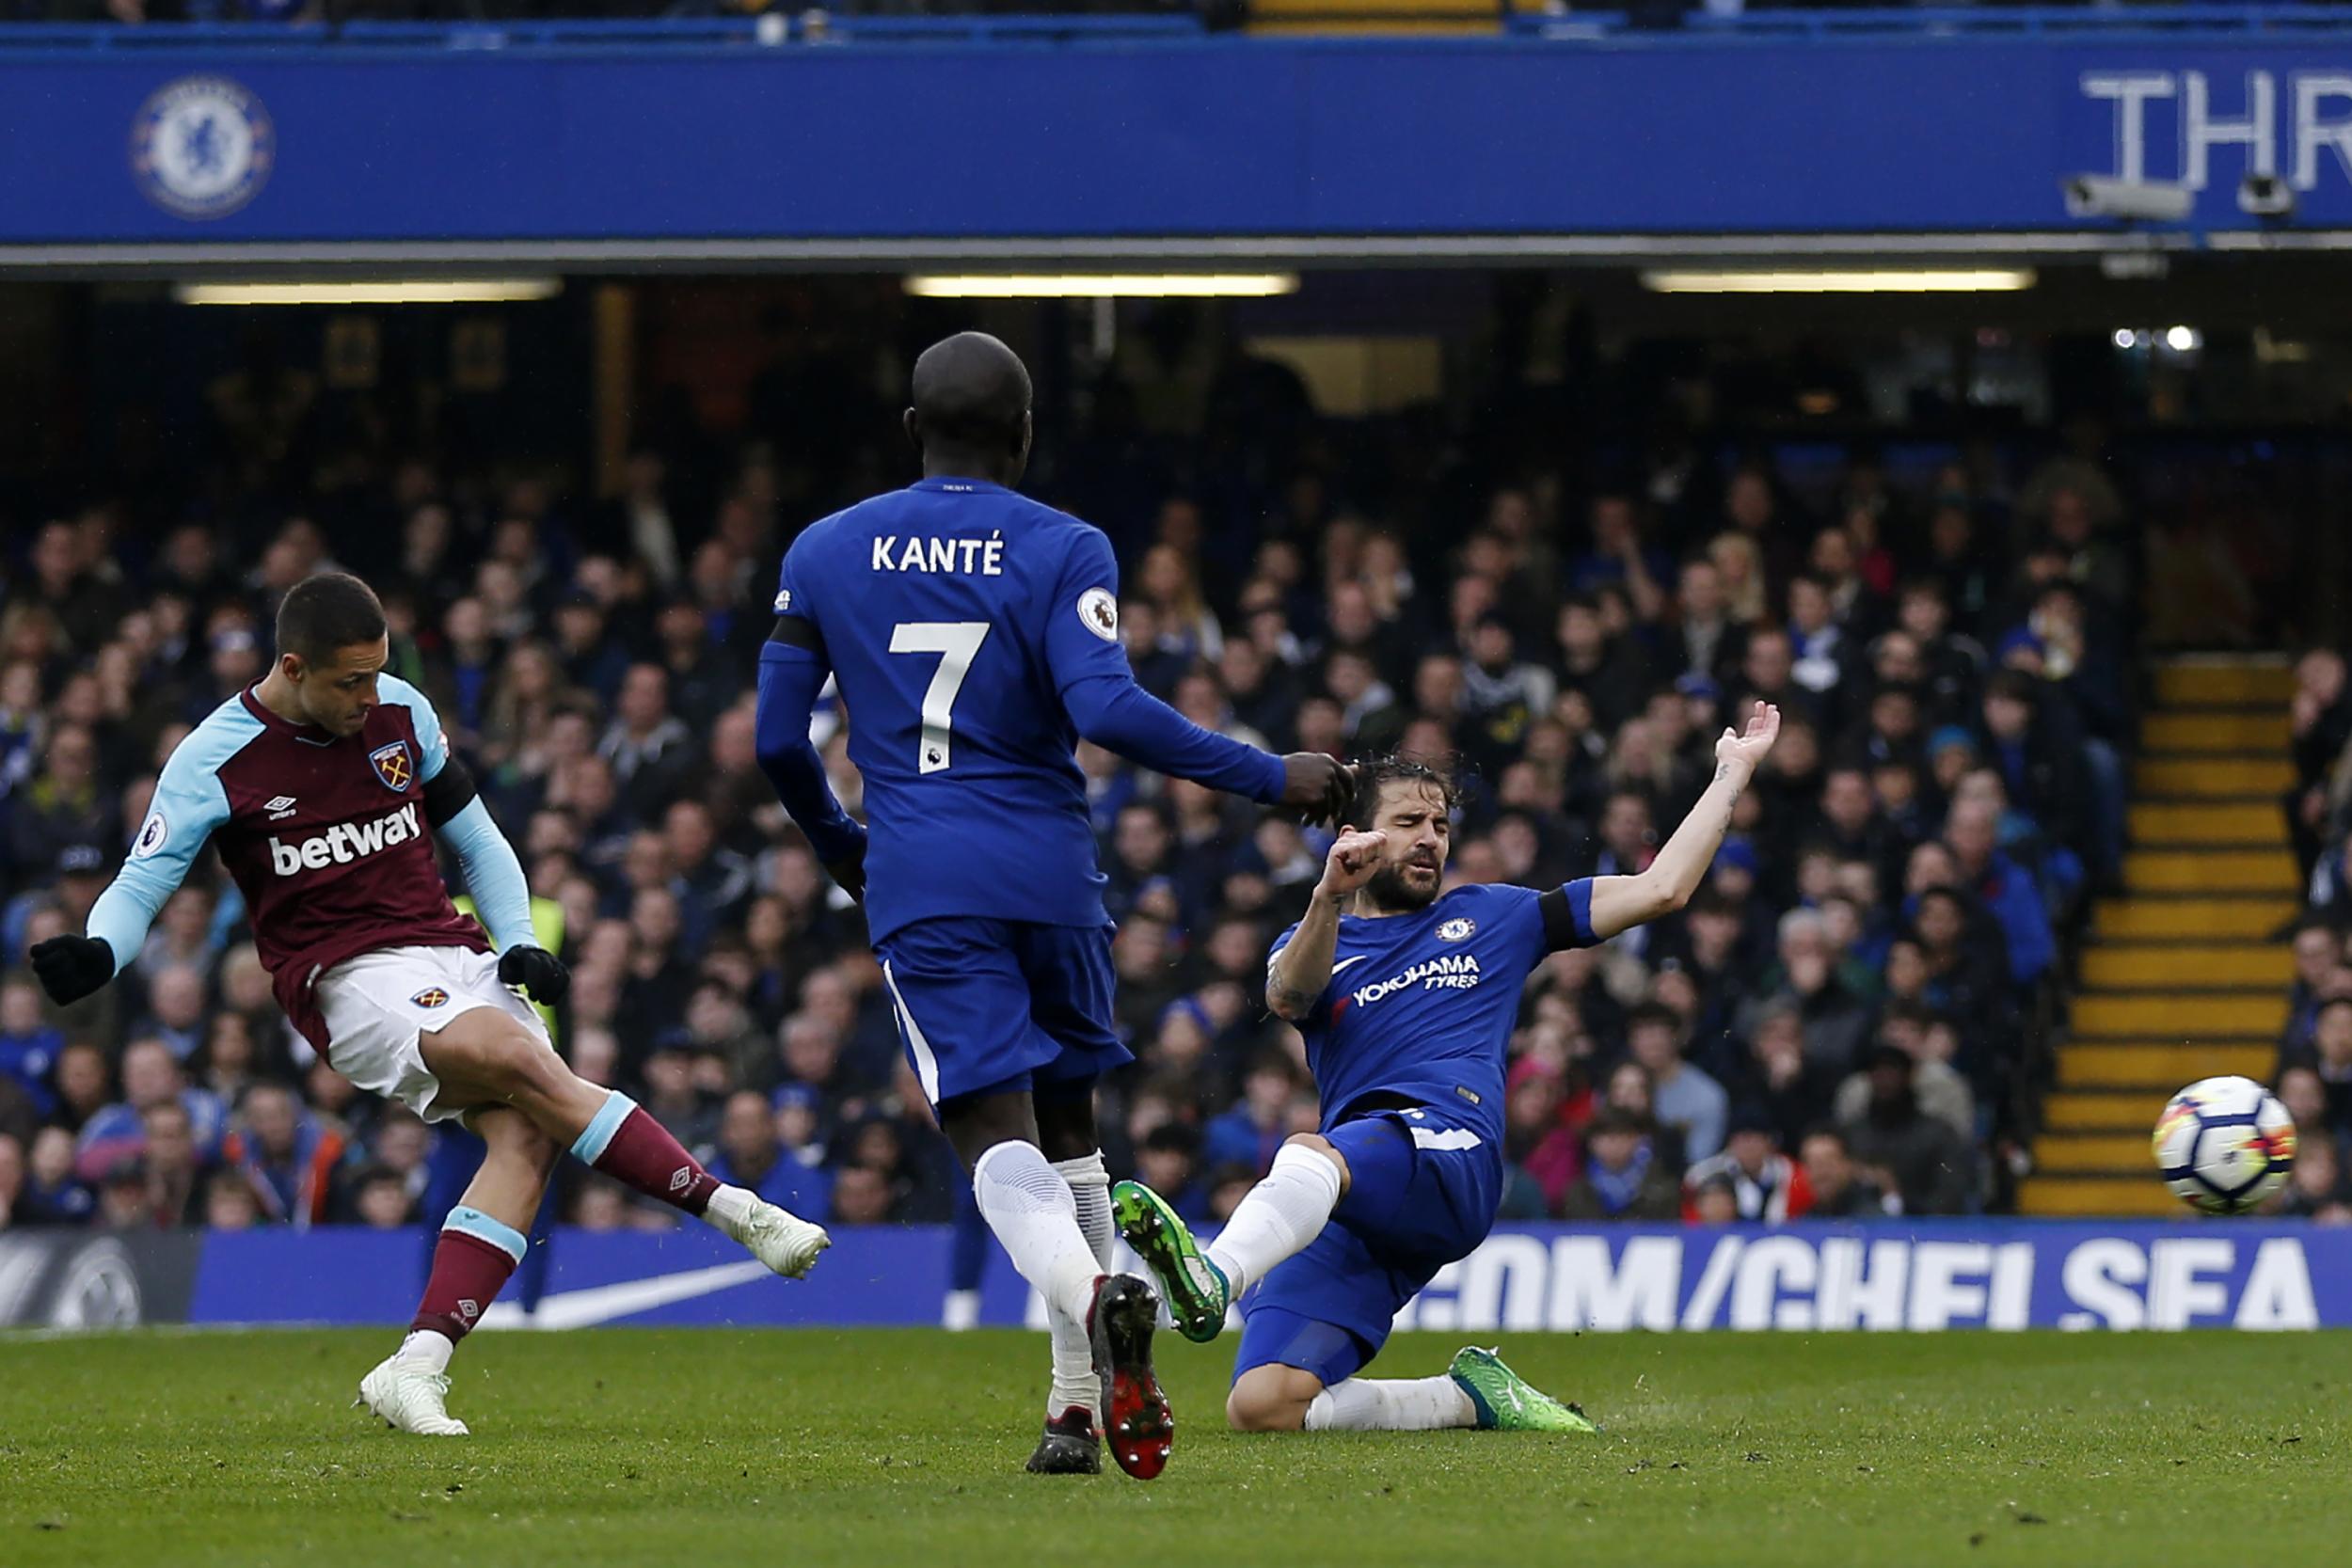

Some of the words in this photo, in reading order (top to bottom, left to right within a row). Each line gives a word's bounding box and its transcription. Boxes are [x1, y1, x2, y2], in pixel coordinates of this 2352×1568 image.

[872, 529, 1004, 576] KANTÉ
[888, 622, 991, 774] 7
[268, 801, 421, 876] betway
[1353, 955, 1480, 1007] YOKOHAMA
[1424, 974, 1479, 990] TYRES
[1391, 1234, 2321, 1332] OM/CHELSEA
